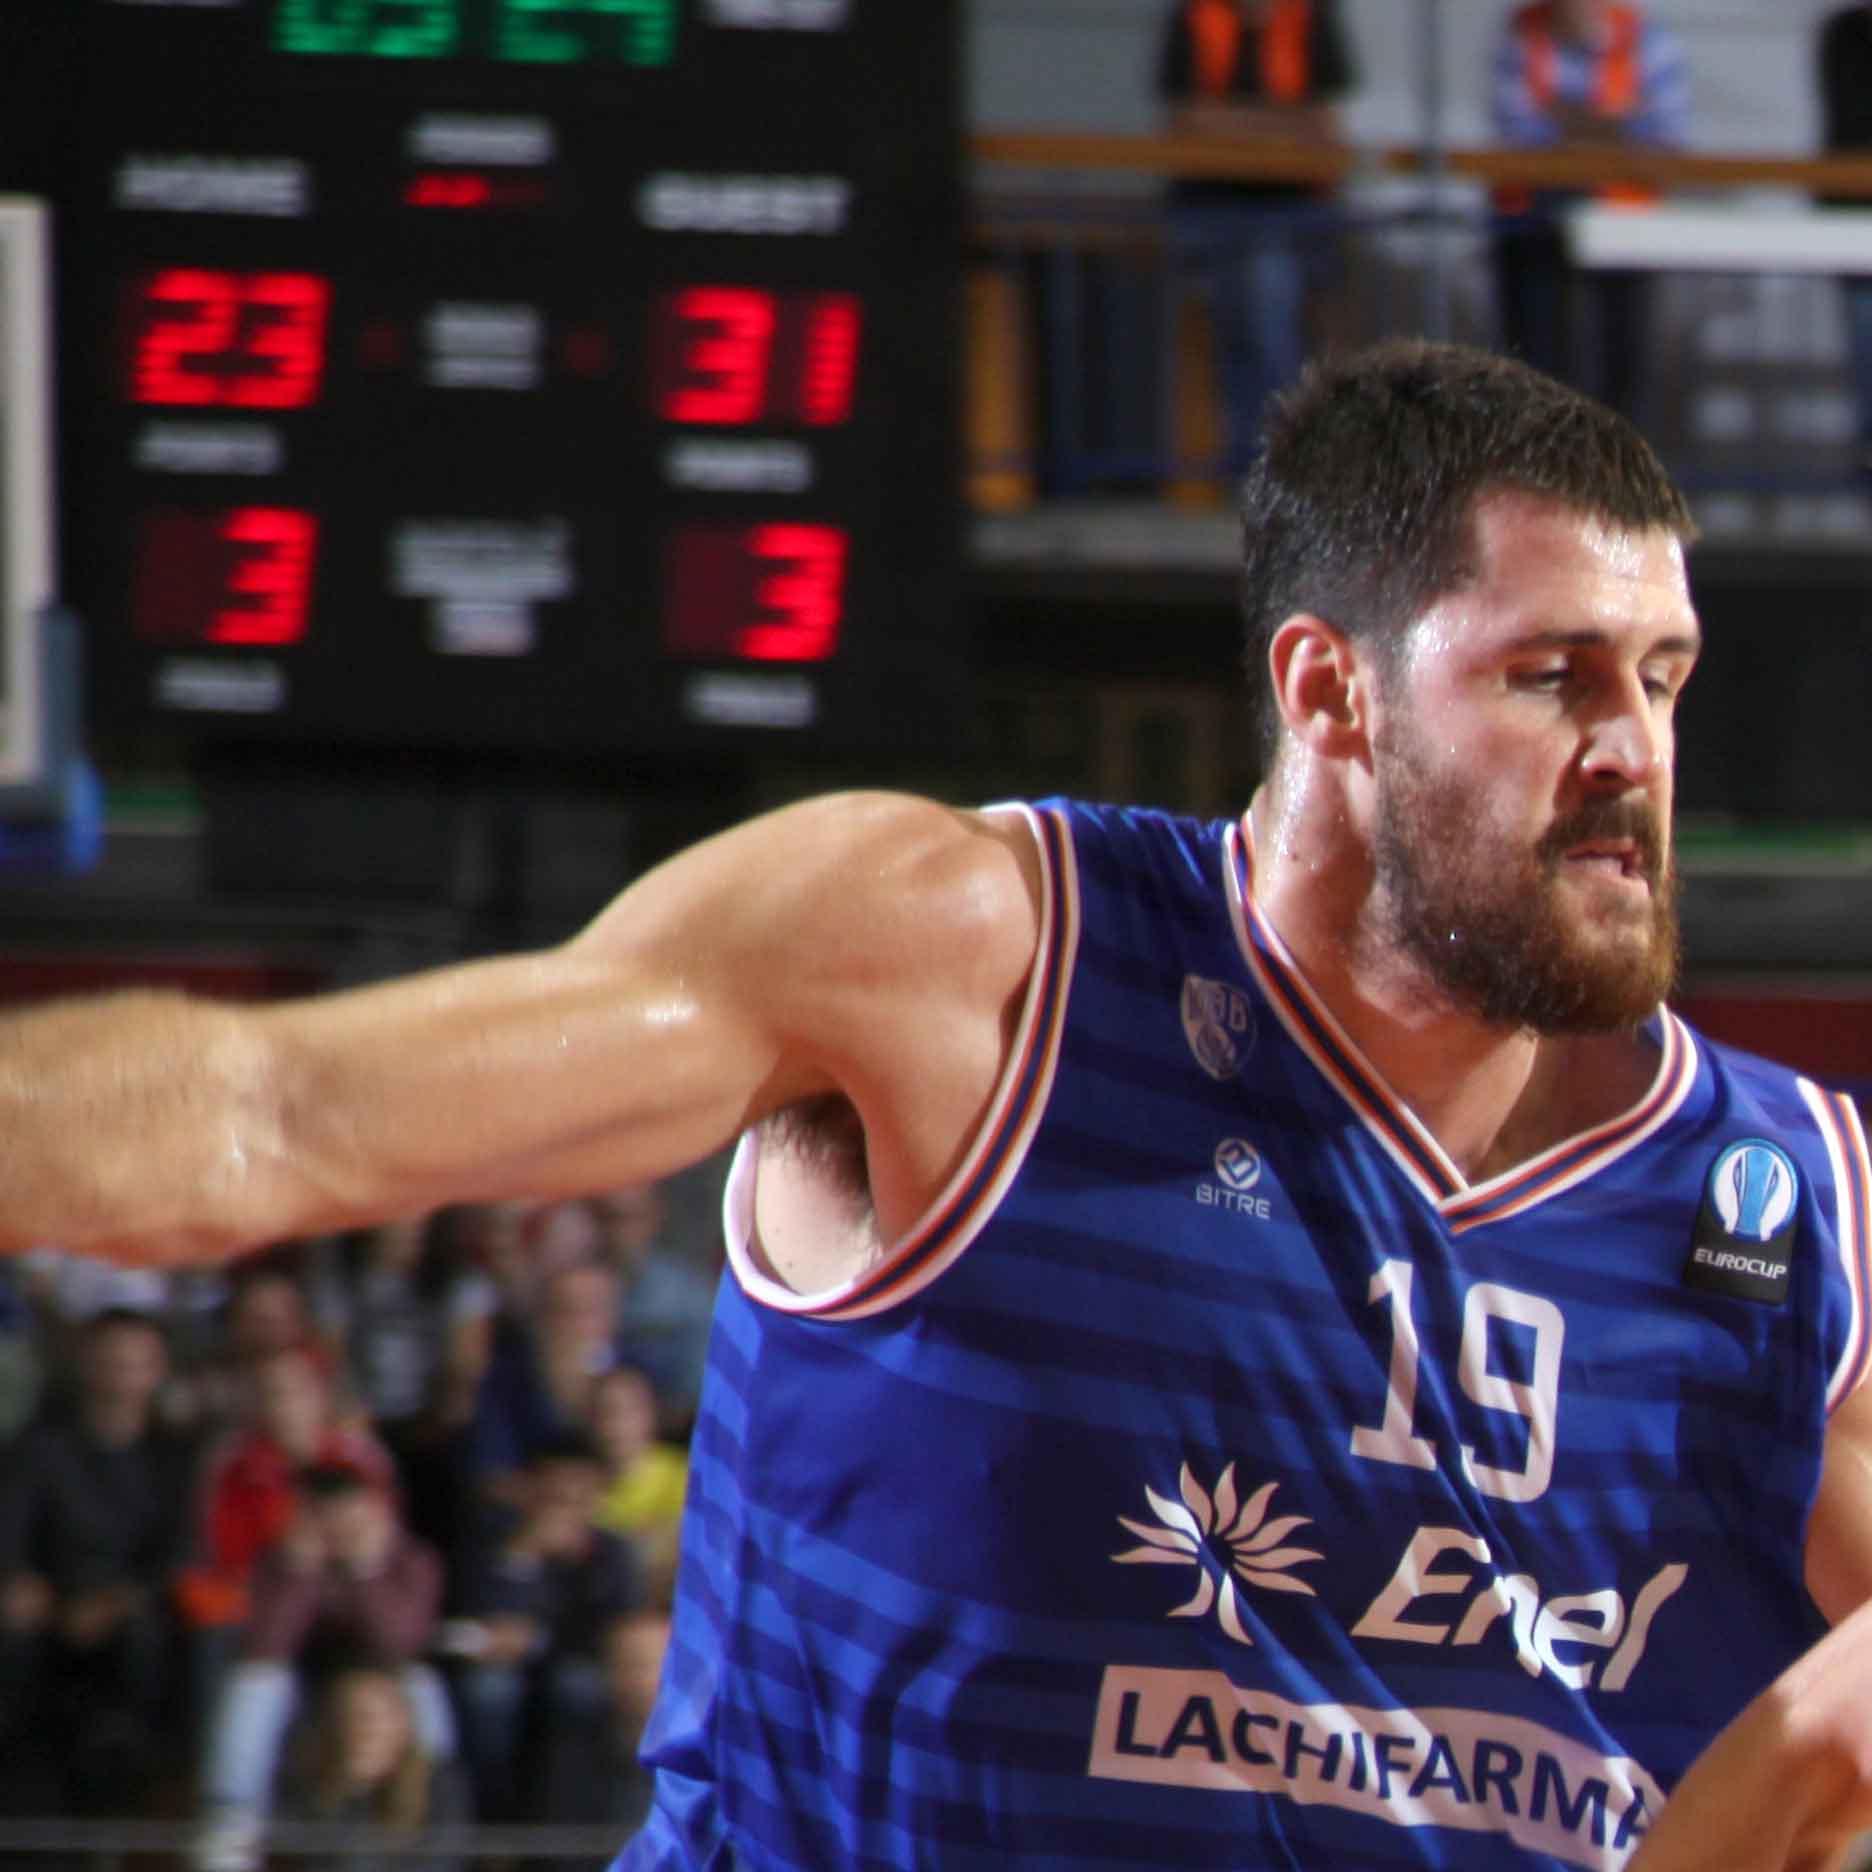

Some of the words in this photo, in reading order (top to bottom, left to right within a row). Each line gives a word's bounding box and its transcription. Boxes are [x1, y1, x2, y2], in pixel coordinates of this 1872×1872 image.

[134, 264, 334, 410] 23
[658, 285, 864, 428] 31
[202, 504, 320, 646] 3
[738, 520, 850, 663] 3
[1694, 1247, 1789, 1281] EUROCUP
[1349, 1258, 1566, 1503] 19
[1350, 1526, 1690, 1694] Enel
[1113, 1690, 1652, 1850] LACHIFARMA
